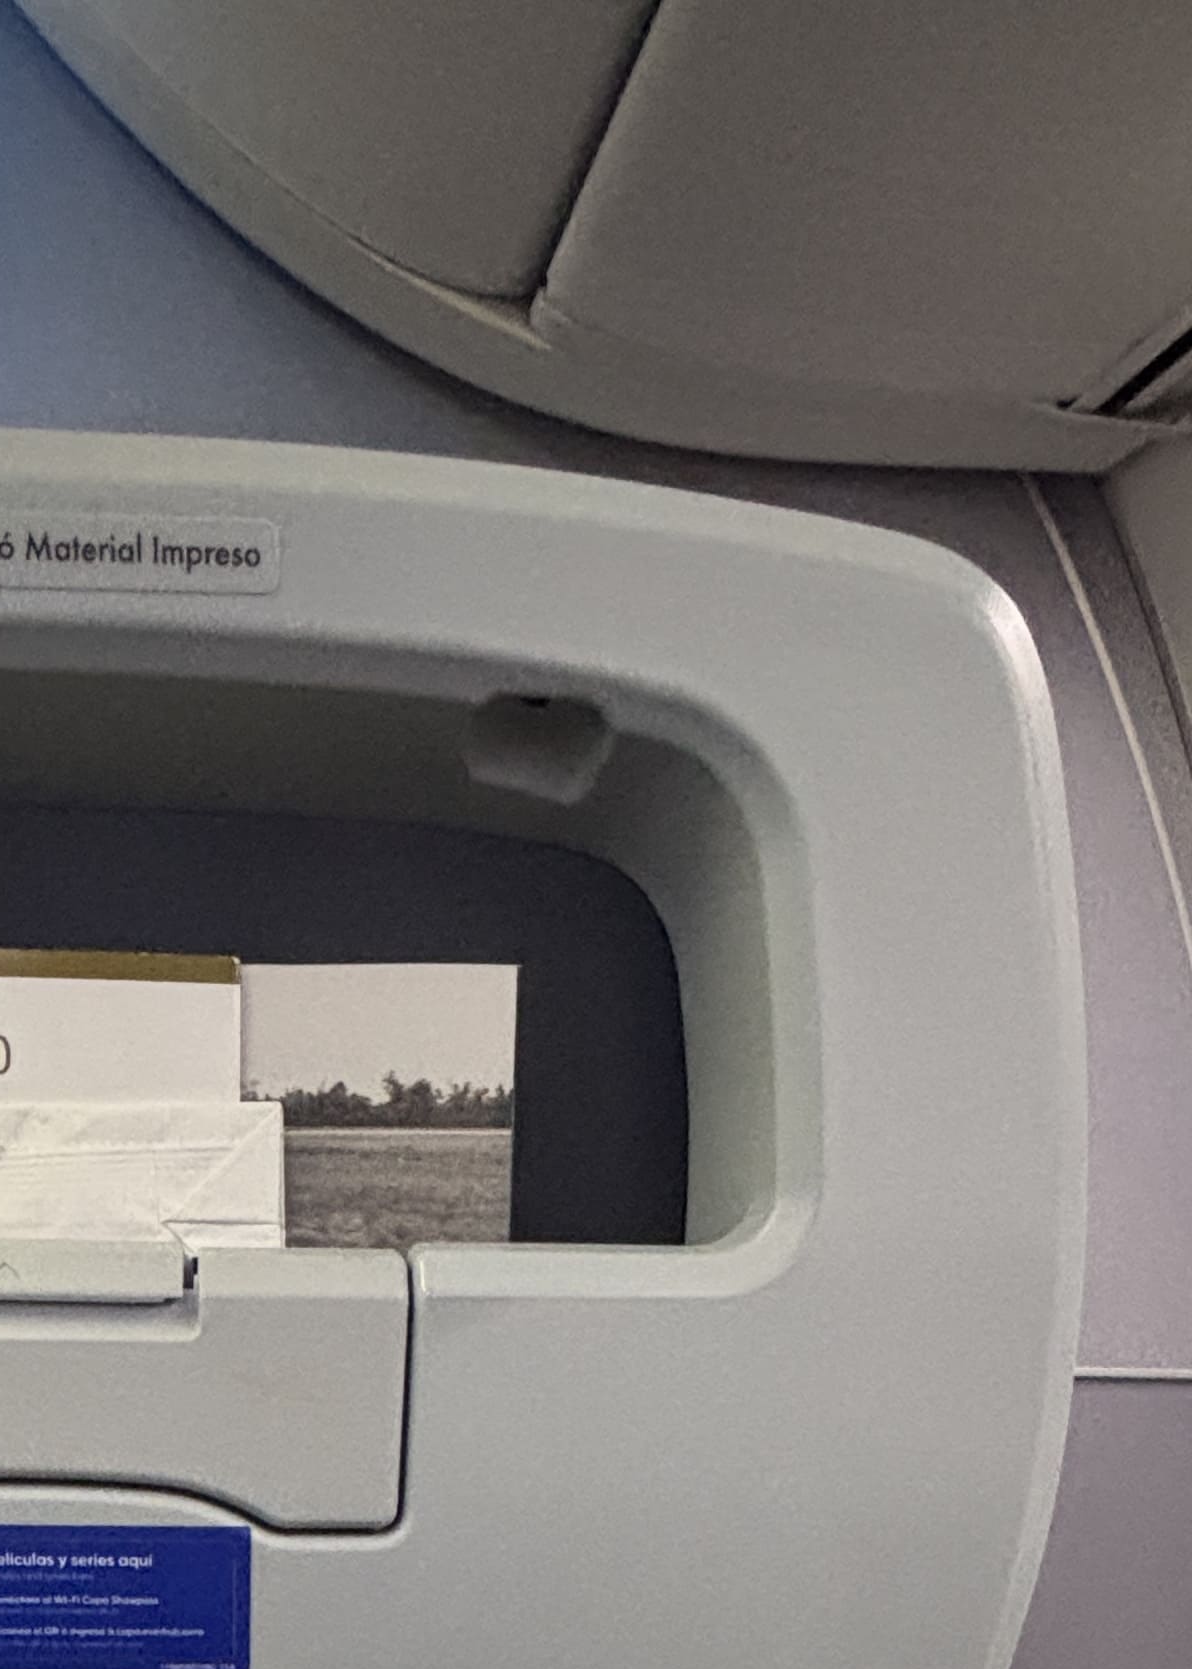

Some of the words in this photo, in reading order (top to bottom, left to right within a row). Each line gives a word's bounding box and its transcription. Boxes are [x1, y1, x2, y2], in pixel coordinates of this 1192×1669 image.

[25, 533, 141, 565] Material
[153, 537, 261, 574] Impreso
[58, 1556, 67, 1569] y
[71, 1554, 115, 1567] series
